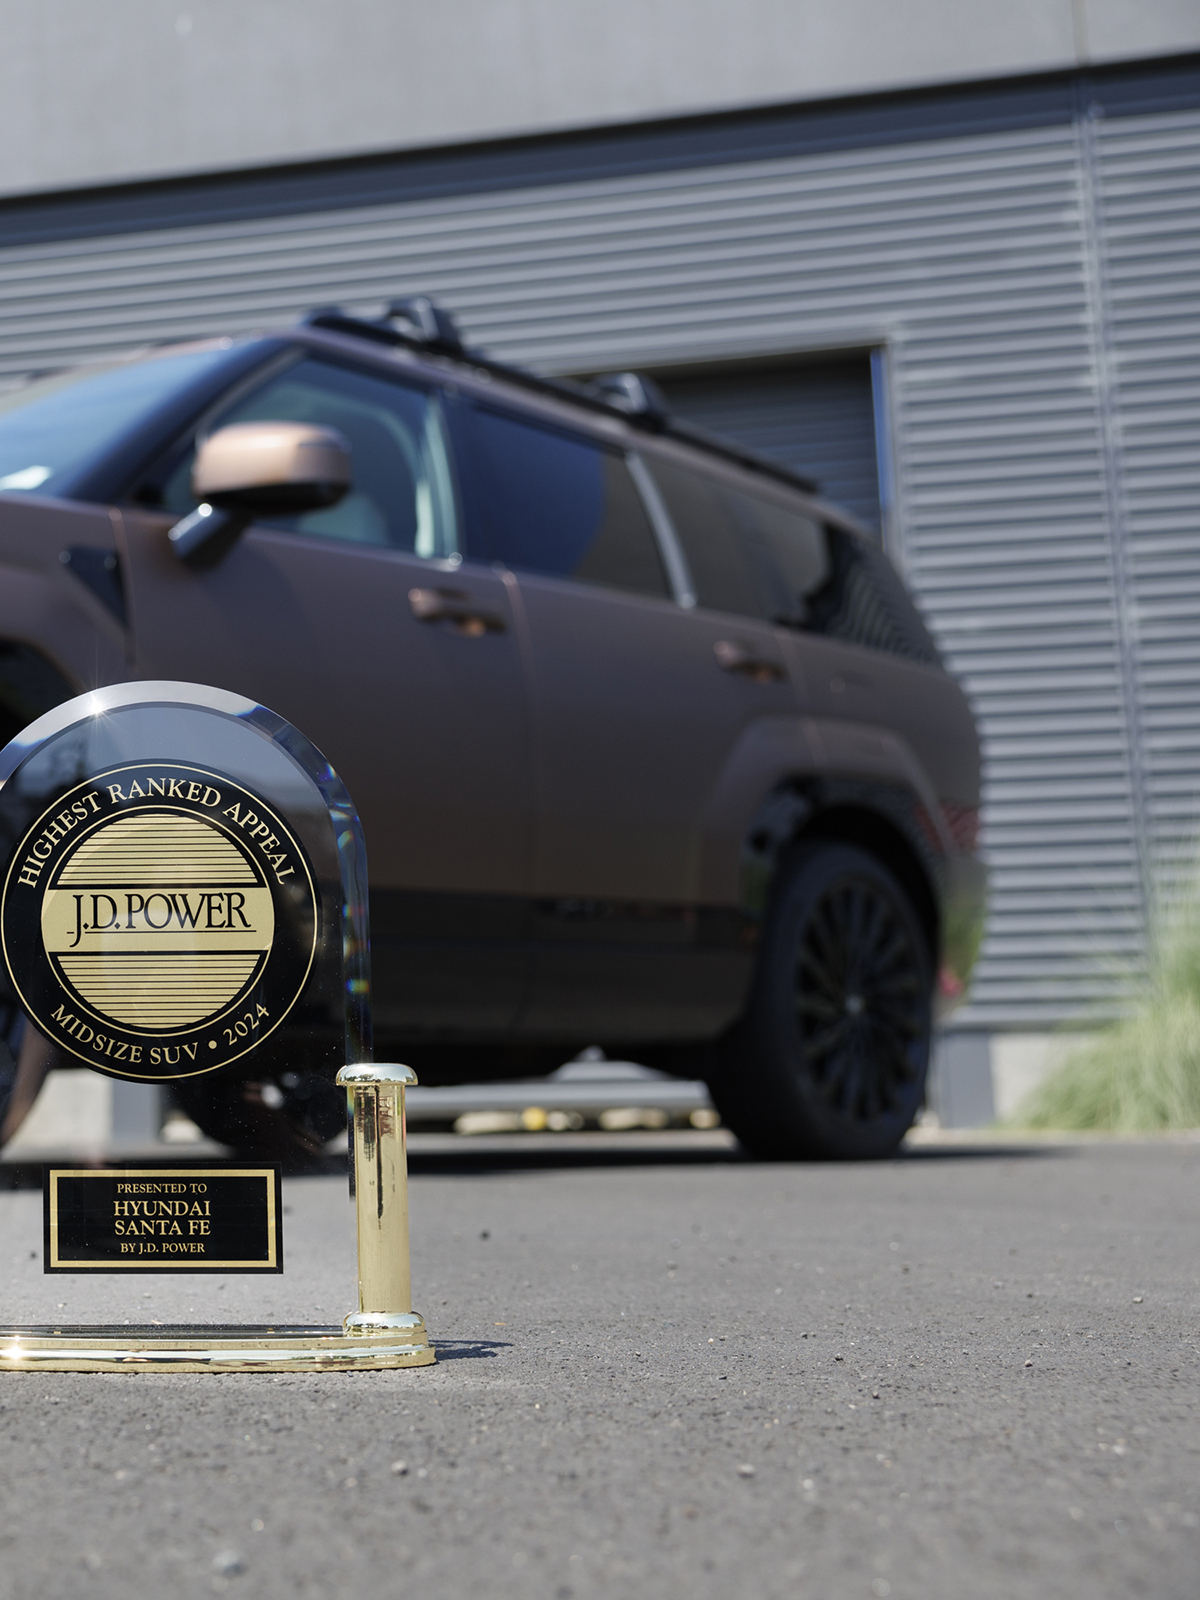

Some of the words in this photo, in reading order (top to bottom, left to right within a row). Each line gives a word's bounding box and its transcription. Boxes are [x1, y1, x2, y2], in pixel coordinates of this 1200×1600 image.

[17, 791, 102, 888] HIGHEST
[107, 777, 222, 807] RANKED
[222, 802, 295, 885] APPEAL
[50, 1003, 143, 1064] MIDSIZE
[150, 1042, 199, 1065] SUV
[223, 1003, 270, 1046] 2024
[117, 1183, 187, 1194] PRESENTED
[189, 1183, 208, 1194] TO
[113, 1200, 211, 1217] HYUNDAI
[114, 1220, 183, 1236] SANTA
[188, 1219, 211, 1236] FE
[120, 1243, 136, 1253] BY
[138, 1243, 159, 1255] J.D.
[162, 1243, 206, 1253] POWER
